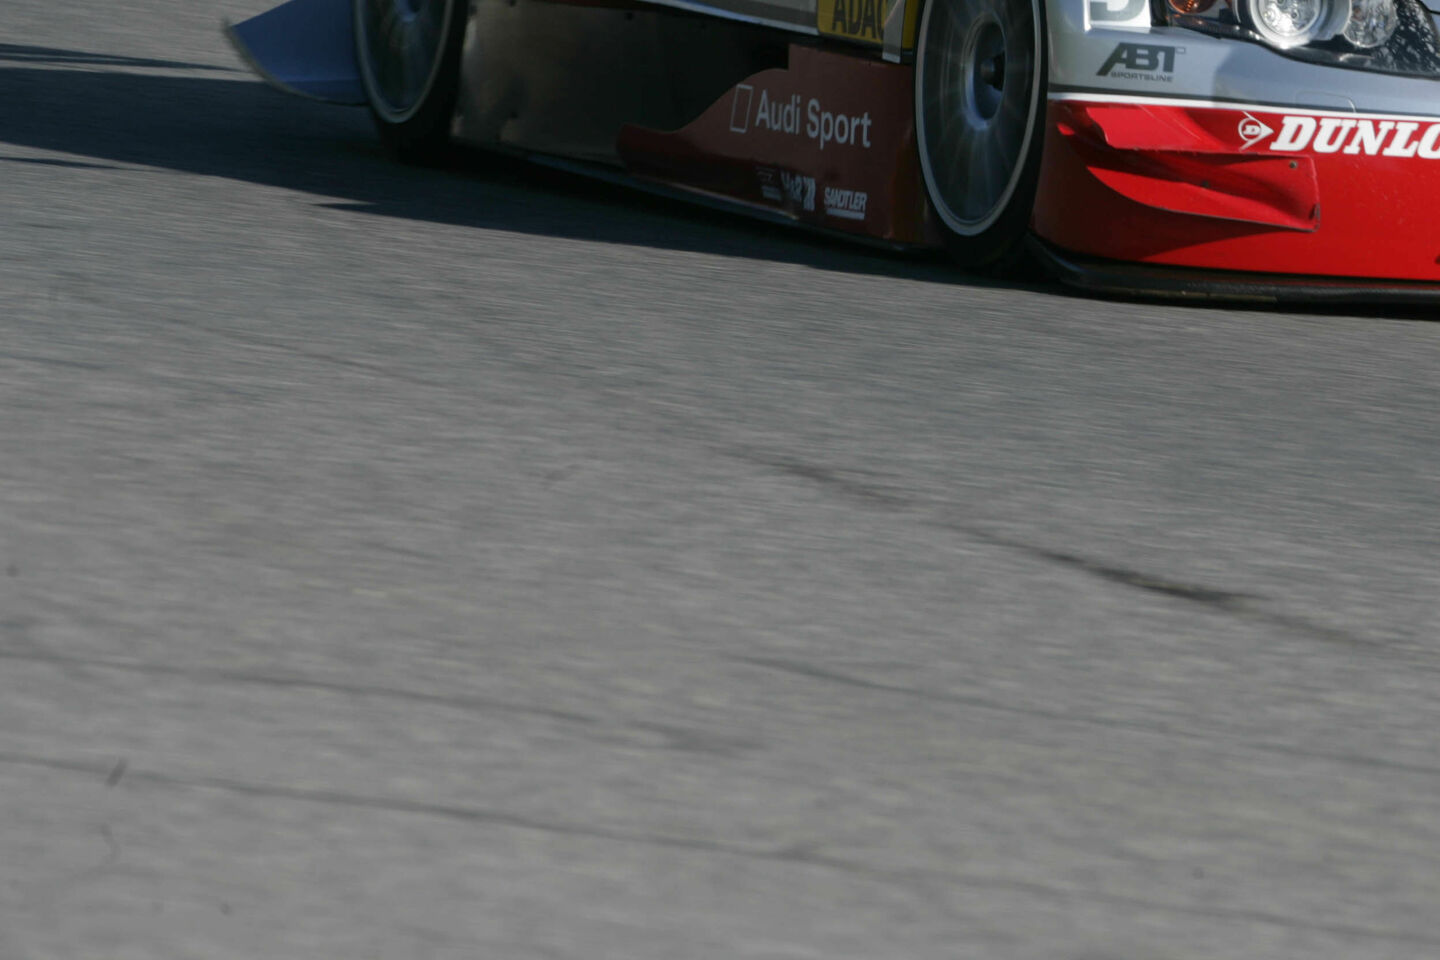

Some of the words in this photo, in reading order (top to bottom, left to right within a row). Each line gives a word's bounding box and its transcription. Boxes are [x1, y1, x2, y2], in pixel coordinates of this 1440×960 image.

[1095, 42, 1176, 77] ABT
[755, 89, 801, 135] Audi
[806, 98, 872, 151] Sport
